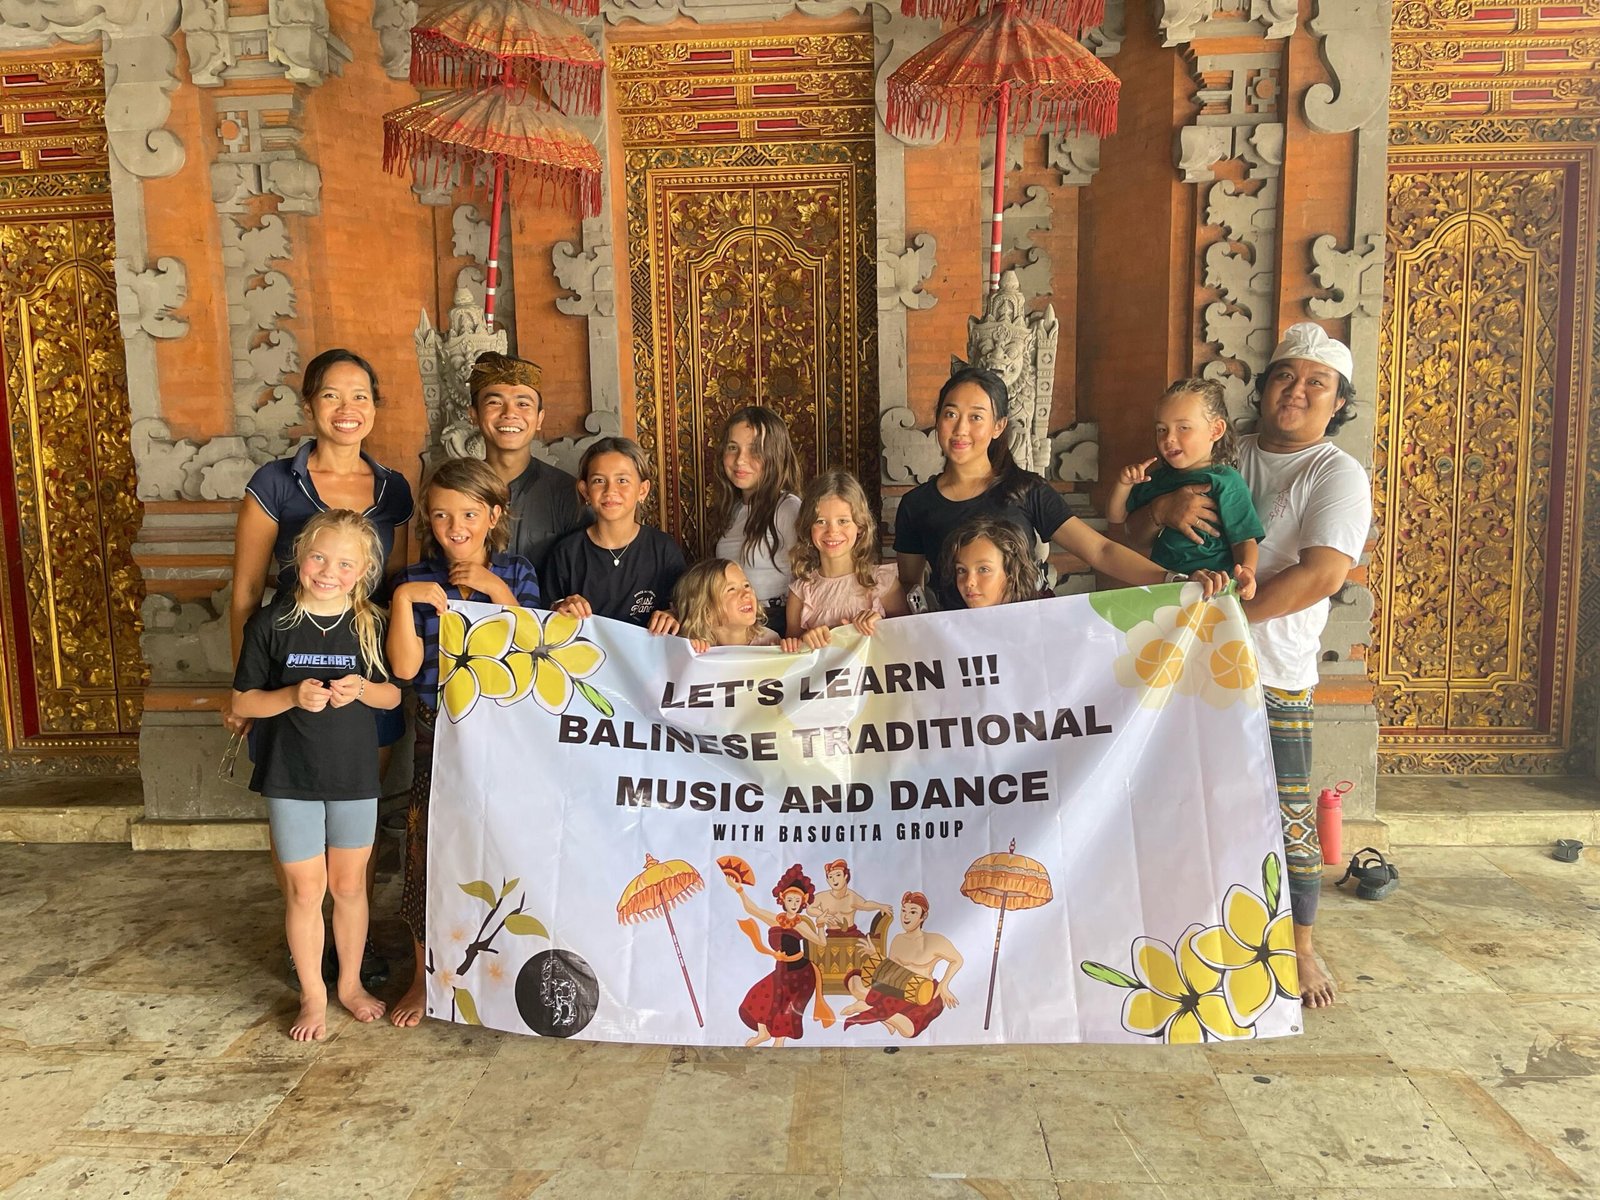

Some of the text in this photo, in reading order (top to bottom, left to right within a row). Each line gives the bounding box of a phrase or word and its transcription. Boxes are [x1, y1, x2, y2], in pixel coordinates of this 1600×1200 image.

[286, 653, 357, 670] MINECRAFT
[660, 678, 784, 709] LET'S
[800, 659, 946, 701] LEARN
[558, 705, 1113, 762] BALINESE TRADITIONAL
[615, 770, 1050, 814] MUSIC AND DANCE
[712, 820, 965, 843] WITH BASUGITA GROUP
